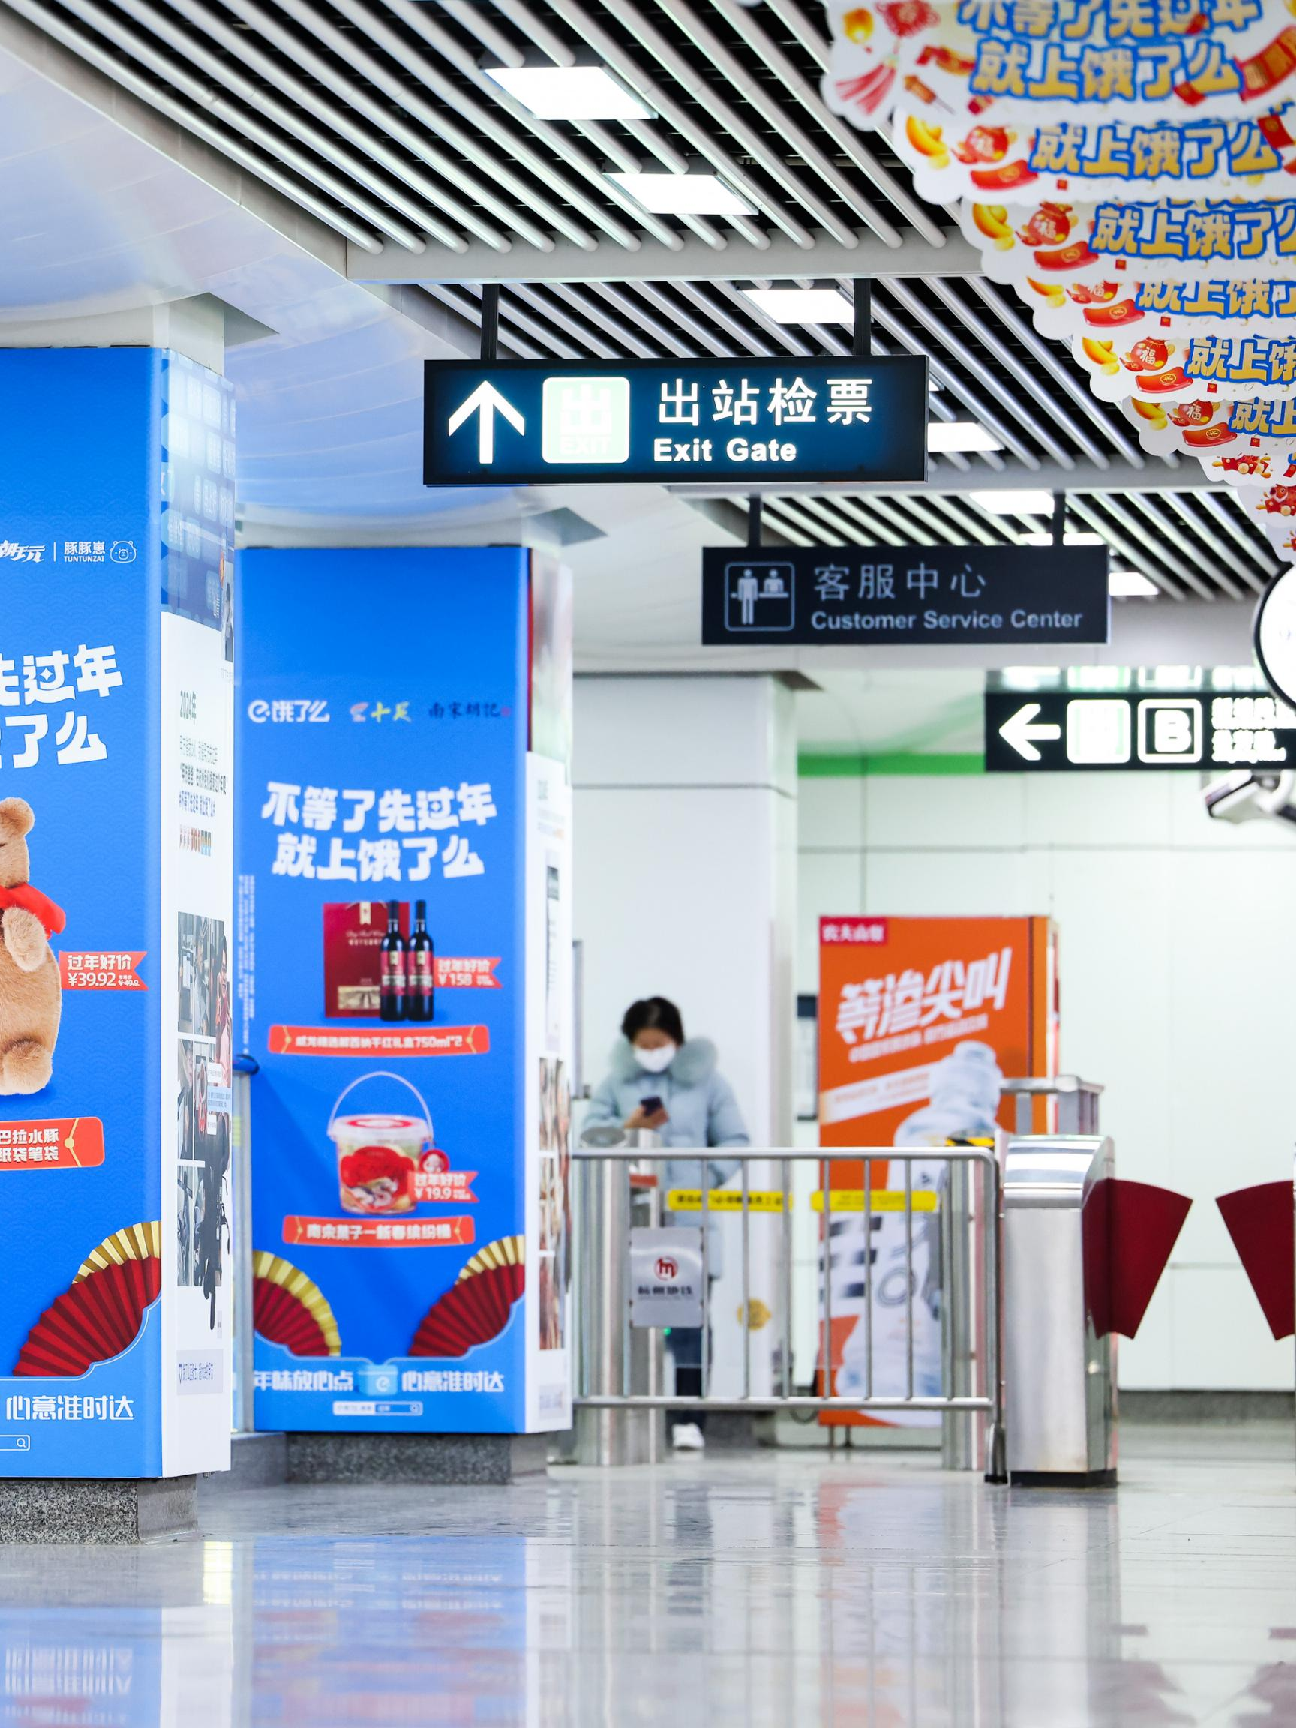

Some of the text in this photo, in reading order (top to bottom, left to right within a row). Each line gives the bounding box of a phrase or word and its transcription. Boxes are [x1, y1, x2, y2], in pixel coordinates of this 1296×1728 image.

[969, 38, 1242, 102] 就上饿了么
[1028, 120, 1283, 180] 就上饿了么
[658, 377, 873, 426] 出站检票
[653, 438, 798, 463] Exit Gate
[64, 555, 105, 563] TUNTUNZAI
[813, 562, 988, 601] 客服中心
[811, 608, 1083, 631] Customer Service Center
[1154, 709, 1192, 753] B
[261, 781, 498, 833] 不等了先过年
[272, 832, 486, 882] 就上饿了么
[67, 954, 132, 970] 过年好价
[67, 971, 117, 987] ¥39.92
[835, 946, 1013, 1045] 等渗尖叫
[6, 1394, 135, 1421] 心意准时达
